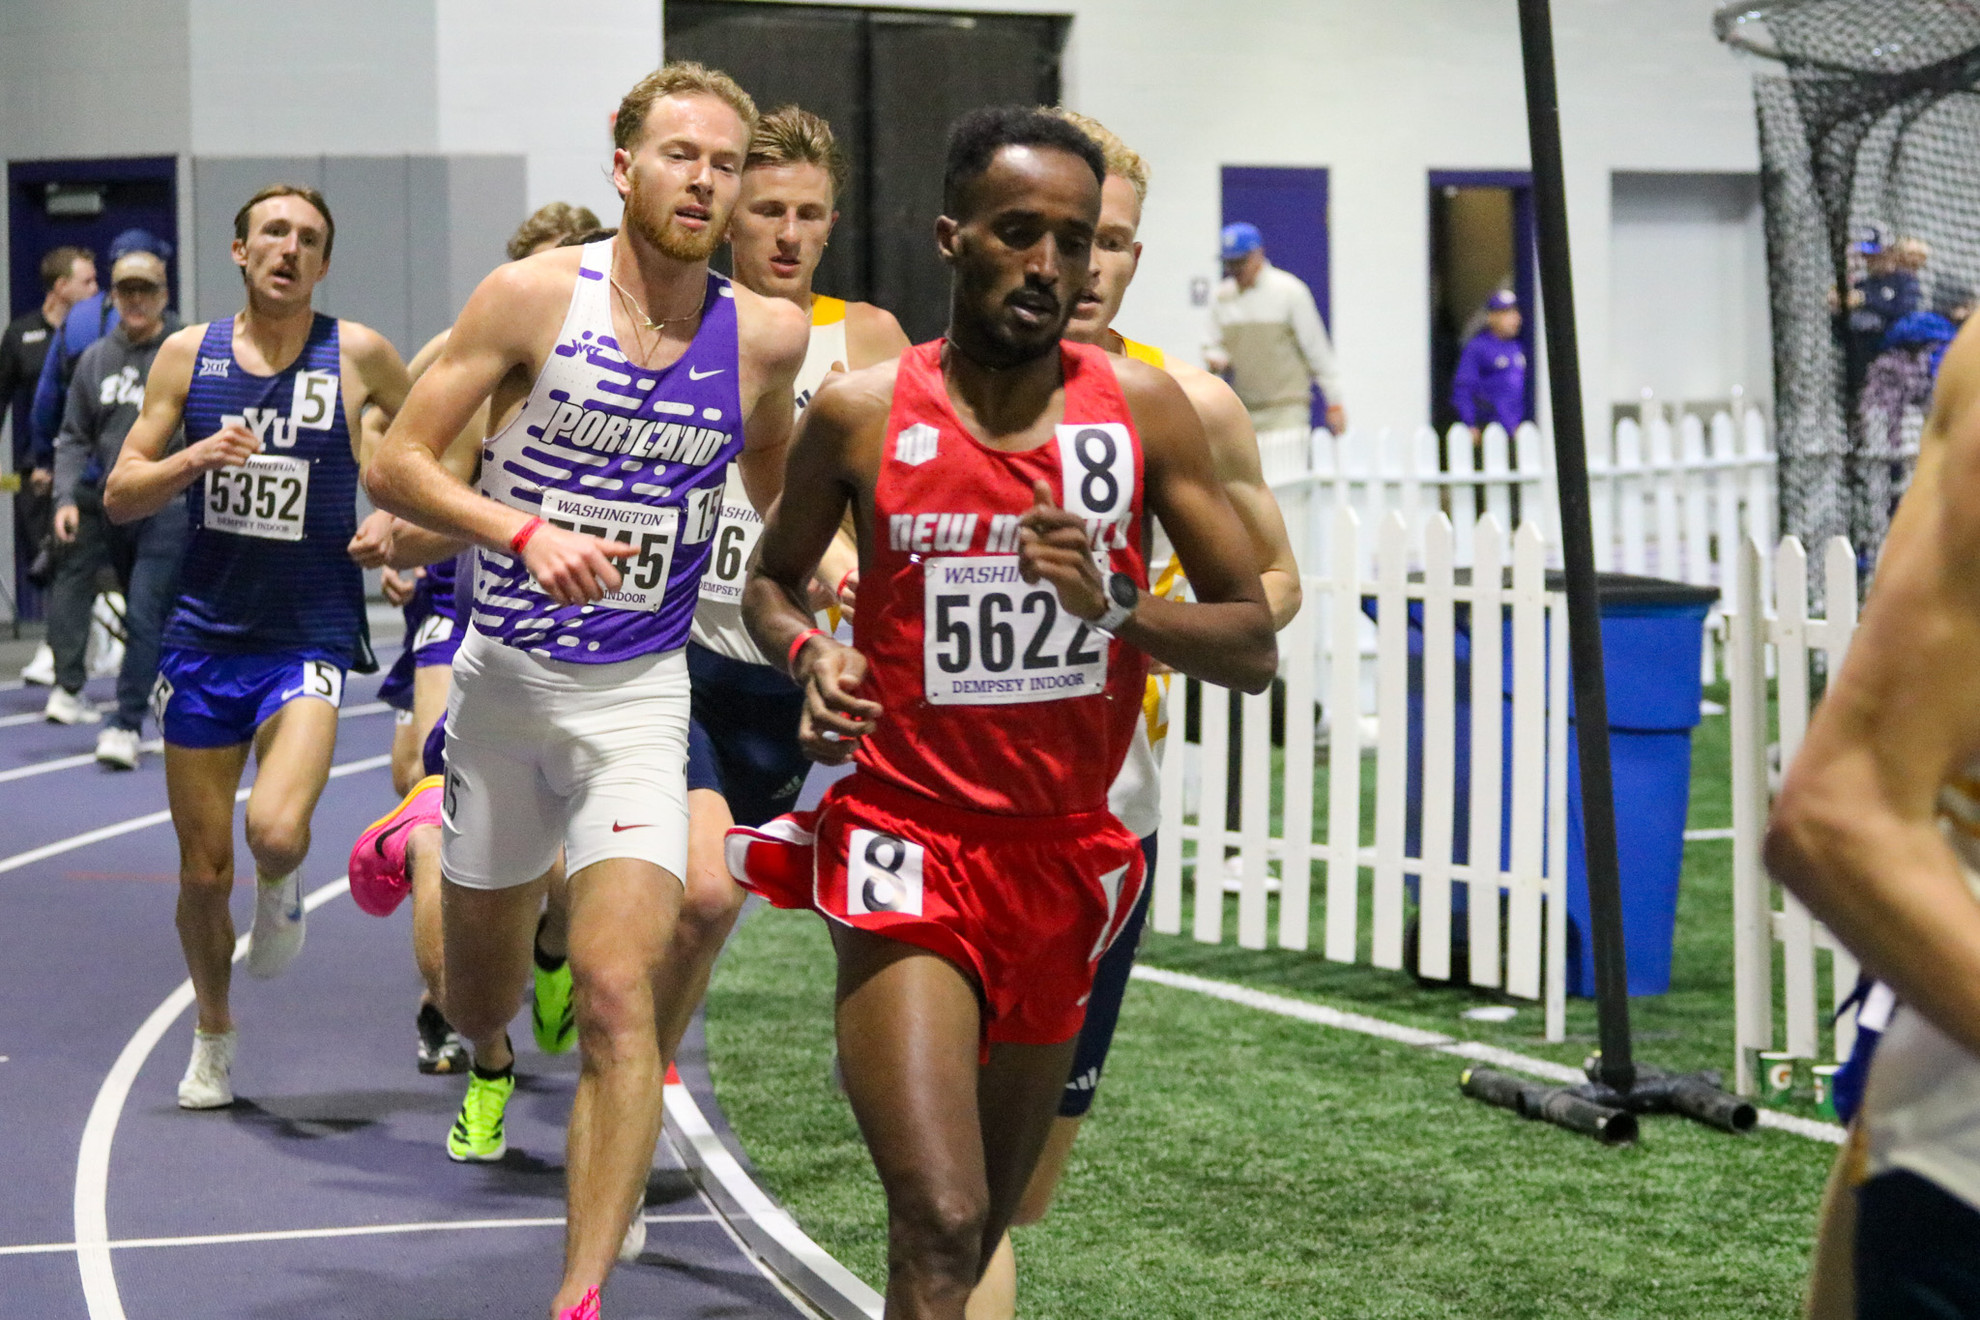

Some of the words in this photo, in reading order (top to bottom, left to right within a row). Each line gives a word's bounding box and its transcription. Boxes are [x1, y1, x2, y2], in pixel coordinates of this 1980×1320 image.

[301, 377, 328, 424] 5
[539, 401, 726, 467] PORTLAND
[1074, 428, 1119, 513] 8
[210, 471, 302, 521] 5352
[557, 499, 665, 527] WASHINGTON
[549, 518, 669, 590] 45
[889, 513, 979, 552] NEW
[985, 511, 1133, 553] MICO
[944, 566, 1019, 584] WASHI
[315, 662, 335, 696] 5
[952, 679, 1025, 694] DEMPSEY
[1030, 673, 1085, 691] INDOOR
